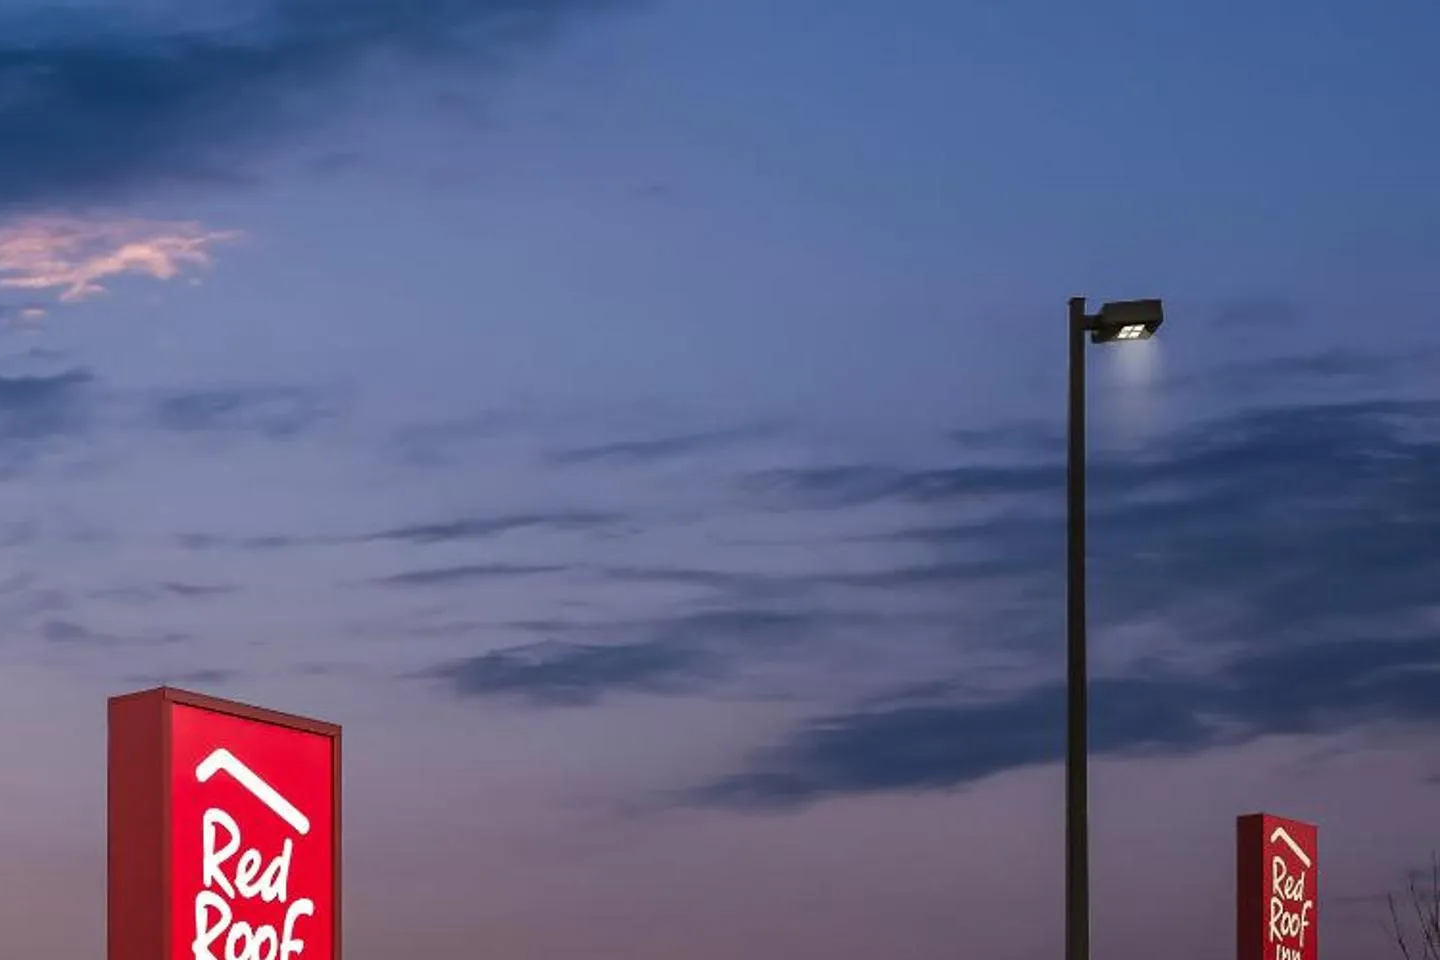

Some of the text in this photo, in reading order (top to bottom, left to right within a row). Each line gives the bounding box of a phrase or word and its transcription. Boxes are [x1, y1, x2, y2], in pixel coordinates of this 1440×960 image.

[203, 808, 292, 903] Red
[1272, 856, 1305, 901] Red
[1269, 897, 1312, 947] Roof
